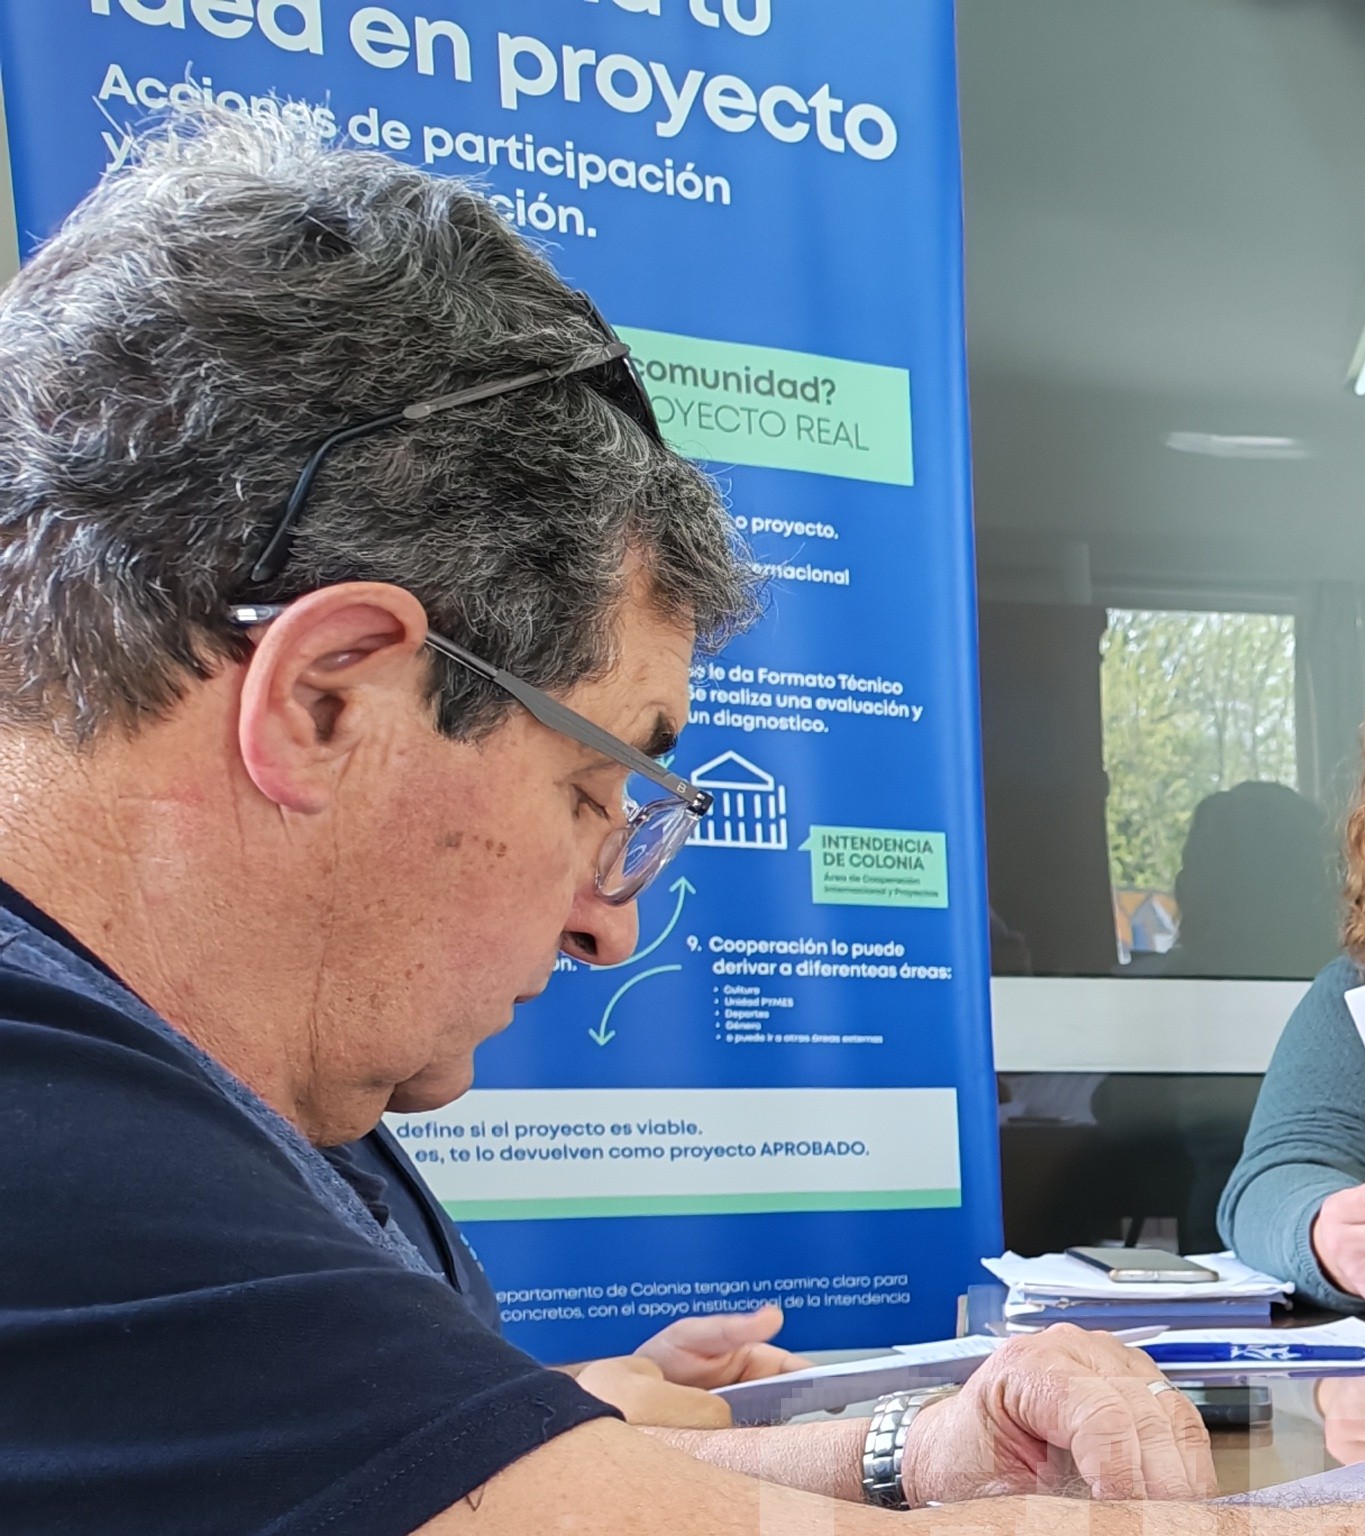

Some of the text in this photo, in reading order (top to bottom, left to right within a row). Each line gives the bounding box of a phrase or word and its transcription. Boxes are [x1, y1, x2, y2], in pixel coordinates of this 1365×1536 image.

[349, 7, 472, 82] en
[498, 32, 898, 161] proyecto
[348, 107, 411, 150] de
[424, 125, 731, 205] participación
[796, 414, 870, 451] REAL
[751, 515, 839, 540] proyecto.
[708, 663, 725, 680] le
[728, 664, 754, 683] da
[757, 667, 836, 690] Formato
[837, 674, 903, 696] Técnico
[710, 688, 772, 708] realiza
[776, 695, 812, 710] una
[815, 697, 909, 718] evaluación
[911, 704, 923, 722] y
[713, 709, 829, 733] diagnostico.
[822, 835, 933, 854] INTENDENCIA
[823, 852, 925, 871] DE COLONIA
[686, 936, 905, 960] 9. Cooperación lo puede
[712, 958, 776, 976] derivar
[779, 962, 792, 976] a
[899, 961, 952, 980] áreas:
[397, 1118, 703, 1140] define si el proyecto es viable.
[449, 1147, 471, 1163] te
[476, 1146, 494, 1162] lo
[500, 1144, 604, 1161] devuelven
[608, 1145, 665, 1160] como
[670, 1142, 756, 1162] proyecto
[760, 1140, 870, 1157] APROBADO.
[607, 1284, 627, 1298] de
[631, 1281, 692, 1297] Colonia
[694, 1280, 750, 1296] tengan
[753, 1279, 771, 1292] un
[774, 1276, 830, 1291] camino
[832, 1274, 871, 1288] claro
[873, 1274, 908, 1290] para
[588, 1302, 618, 1318] con
[621, 1300, 635, 1316] el
[638, 1300, 690, 1318] apoyo
[693, 1294, 782, 1313] institucional
[784, 1295, 804, 1309] de
[807, 1293, 821, 1308] la
[824, 1292, 911, 1307] Intendencia
